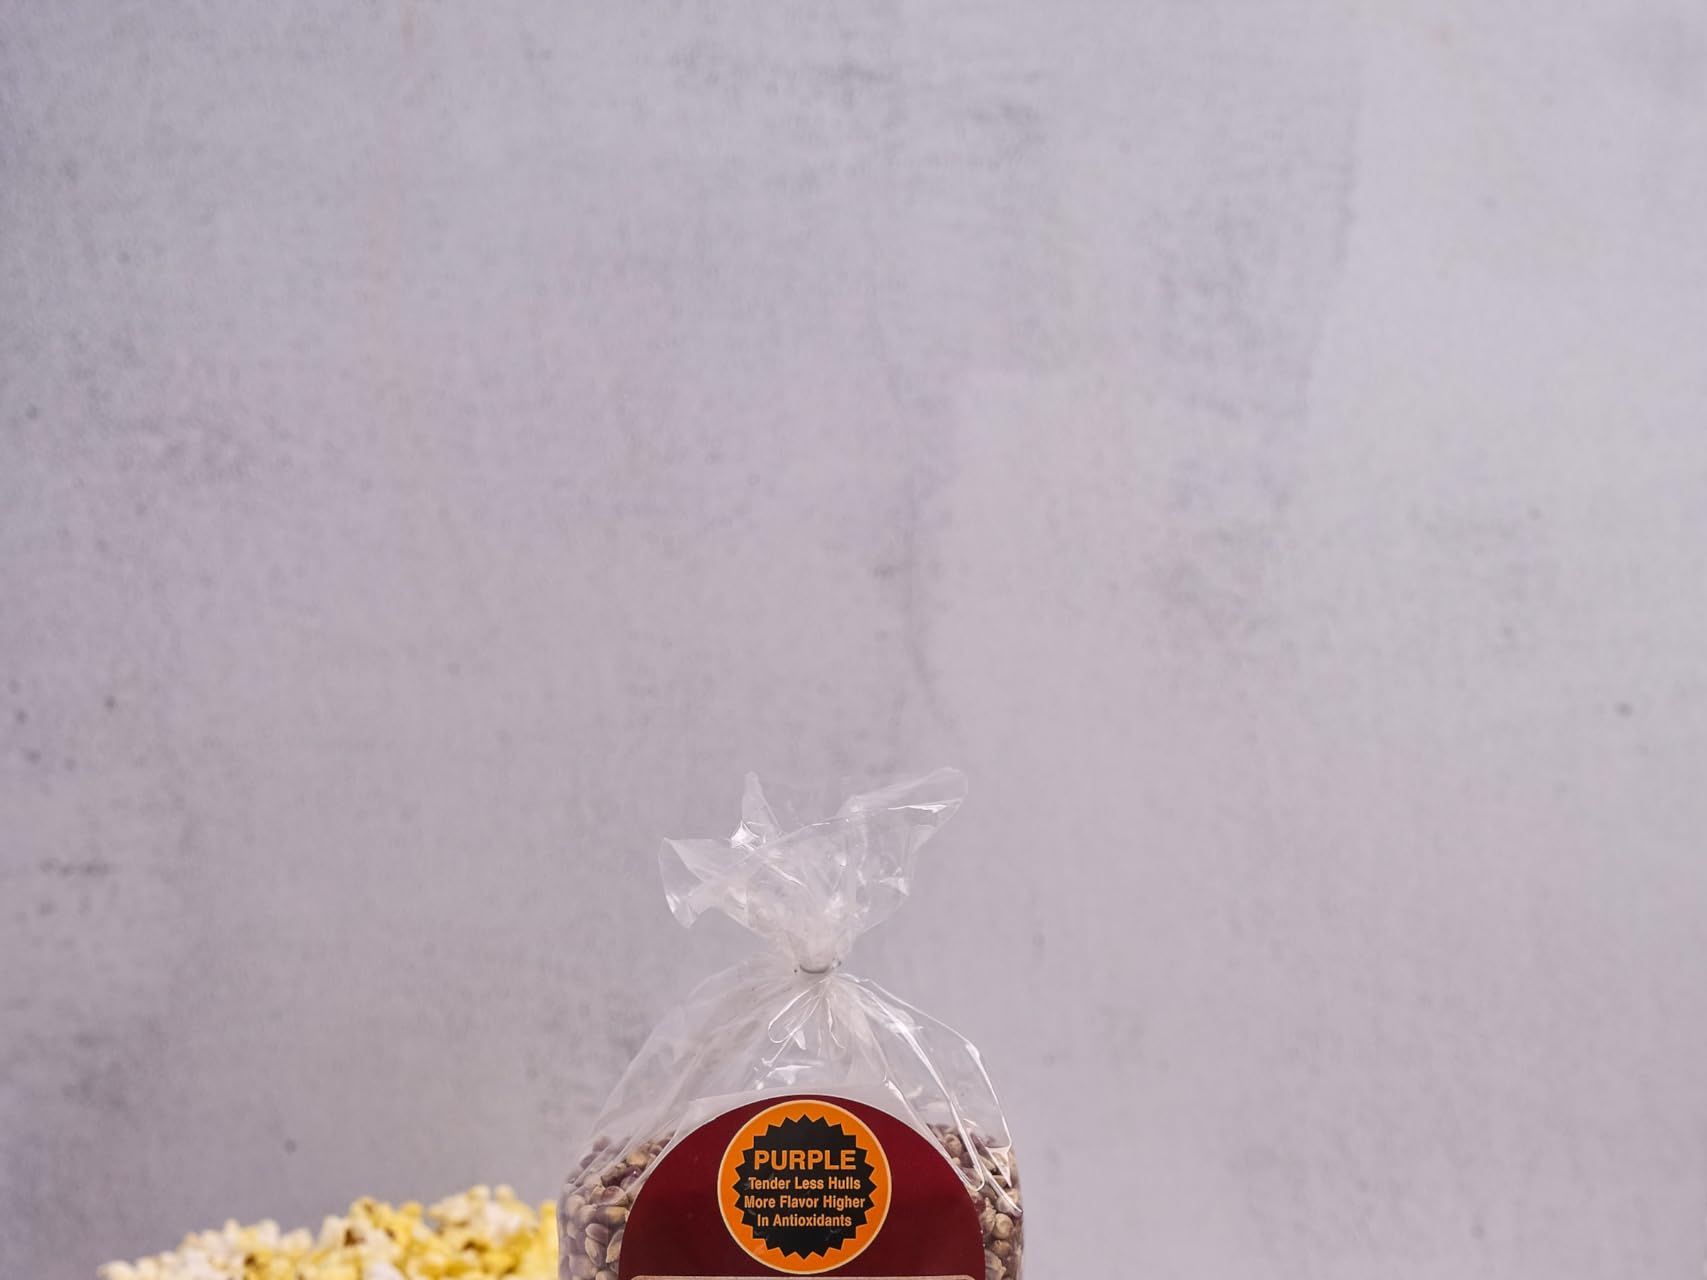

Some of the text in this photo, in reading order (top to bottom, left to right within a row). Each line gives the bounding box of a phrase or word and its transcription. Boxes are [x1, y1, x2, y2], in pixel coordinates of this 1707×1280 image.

[754, 1150, 856, 1171] PURPLE
[748, 1177, 861, 1189] Tender Less Hulls
[744, 1196, 866, 1211] More Flavor Higher
[757, 1215, 852, 1228] In Antioxidants
